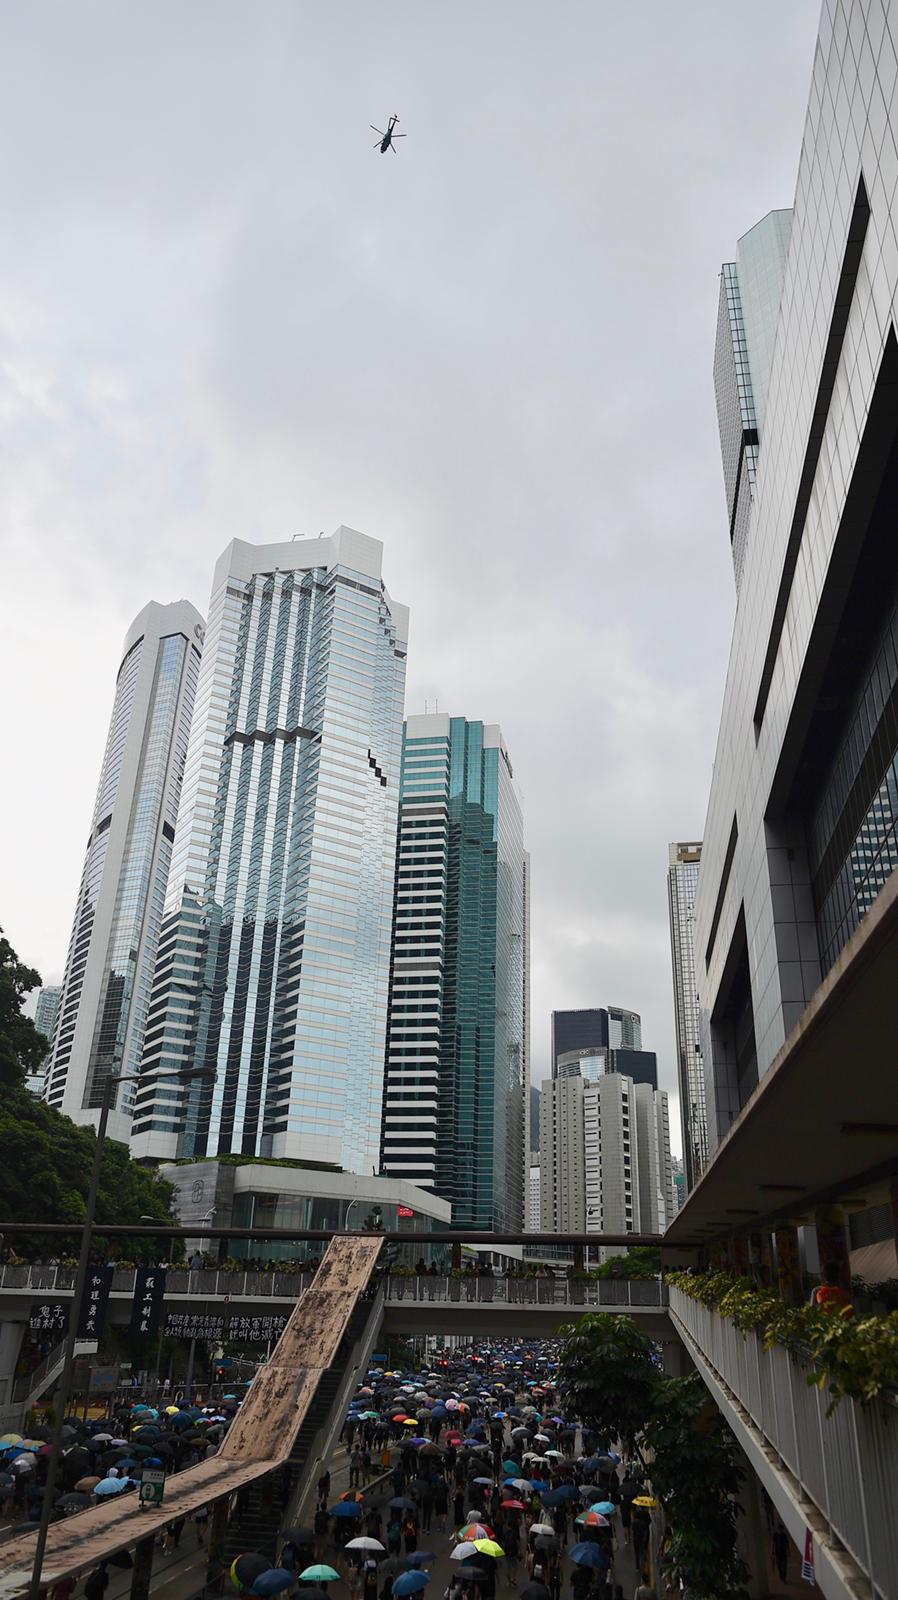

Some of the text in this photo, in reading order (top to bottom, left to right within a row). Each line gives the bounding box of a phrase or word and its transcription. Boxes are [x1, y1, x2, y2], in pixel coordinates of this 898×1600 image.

[38, 1304, 63, 1318] 鬼子
[29, 1311, 65, 1328] 進村了
